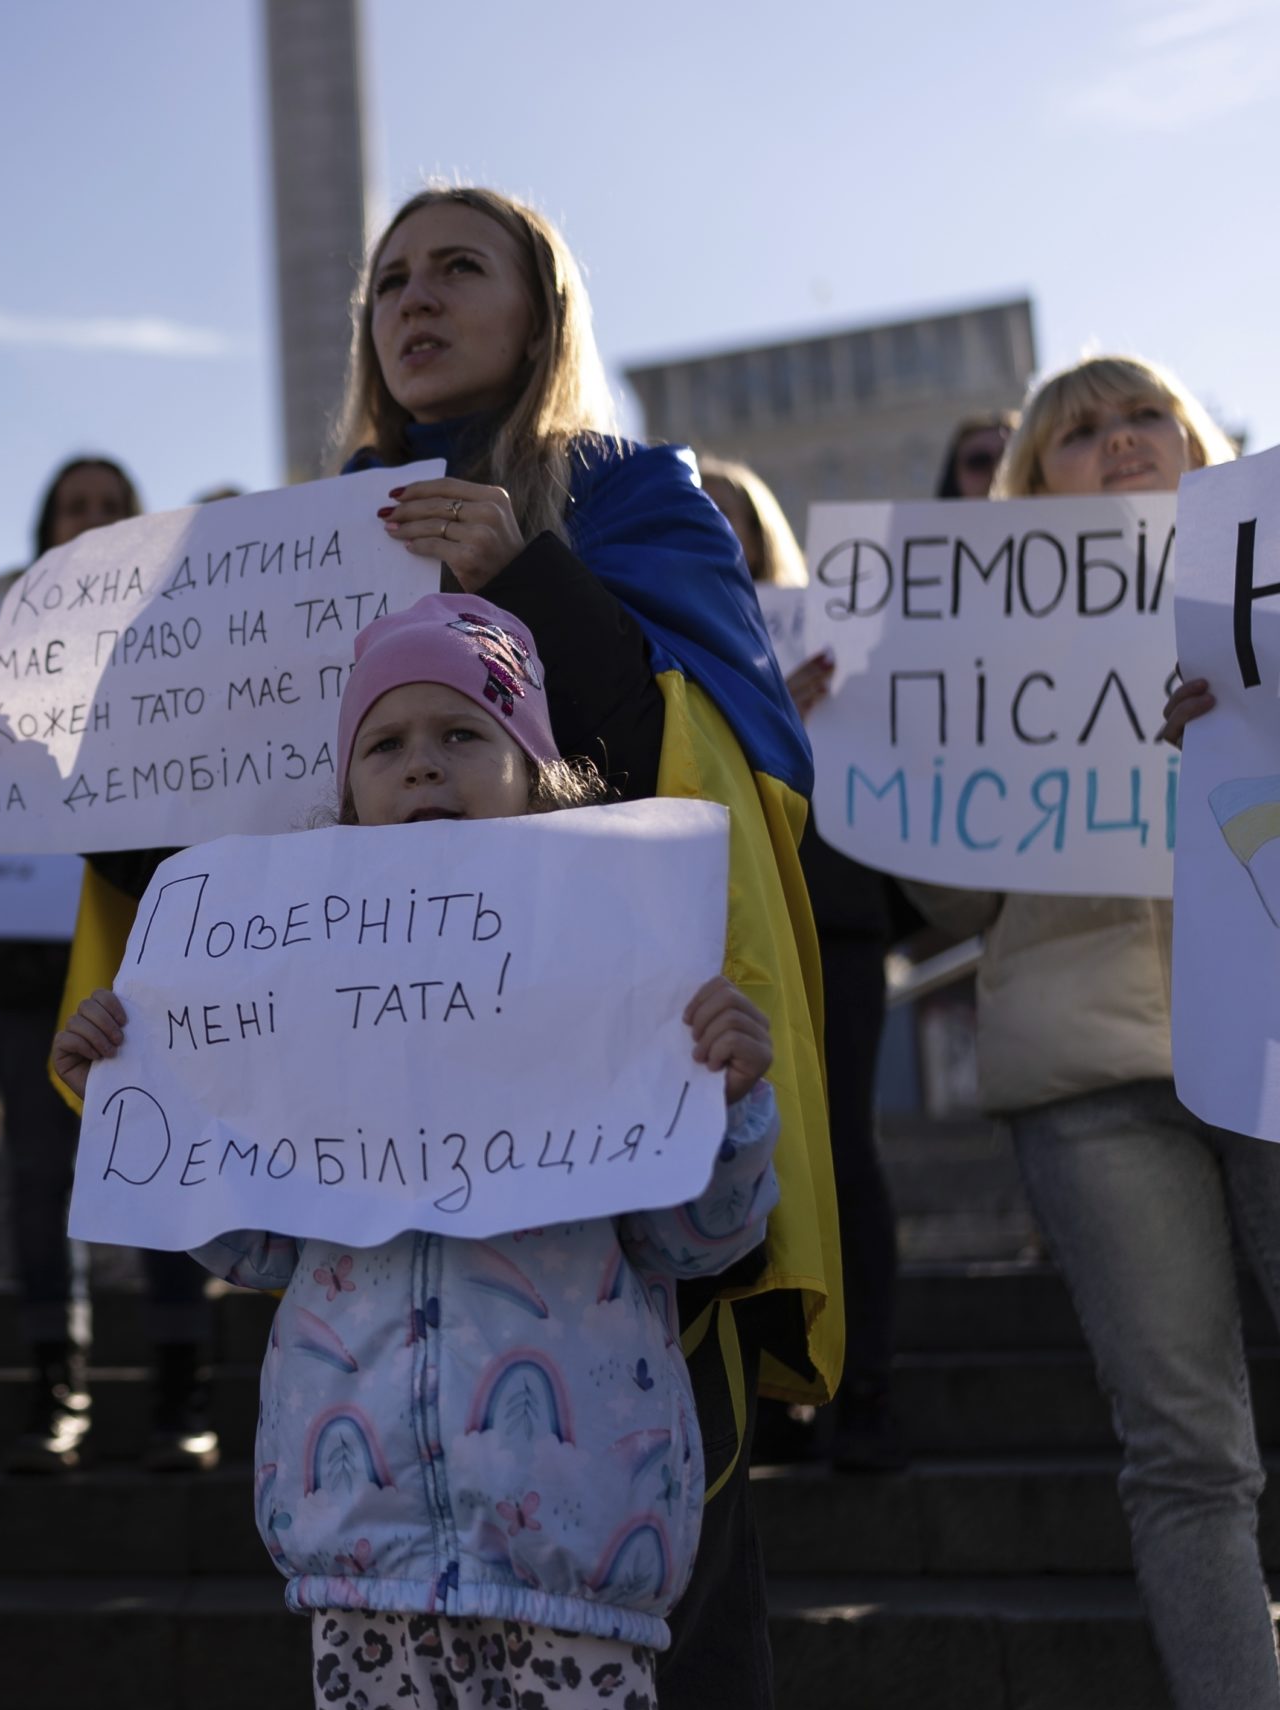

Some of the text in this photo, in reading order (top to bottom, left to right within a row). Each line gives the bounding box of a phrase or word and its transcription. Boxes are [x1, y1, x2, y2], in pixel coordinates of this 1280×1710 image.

[161, 530, 342, 600] ДИТИНА
[94, 616, 201, 667] ПРАВО
[229, 610, 267, 646] НА
[132, 687, 205, 726] ТАТО
[227, 668, 301, 711] МАЄ
[168, 953, 511, 1050] МЕНІ ТАТА!
